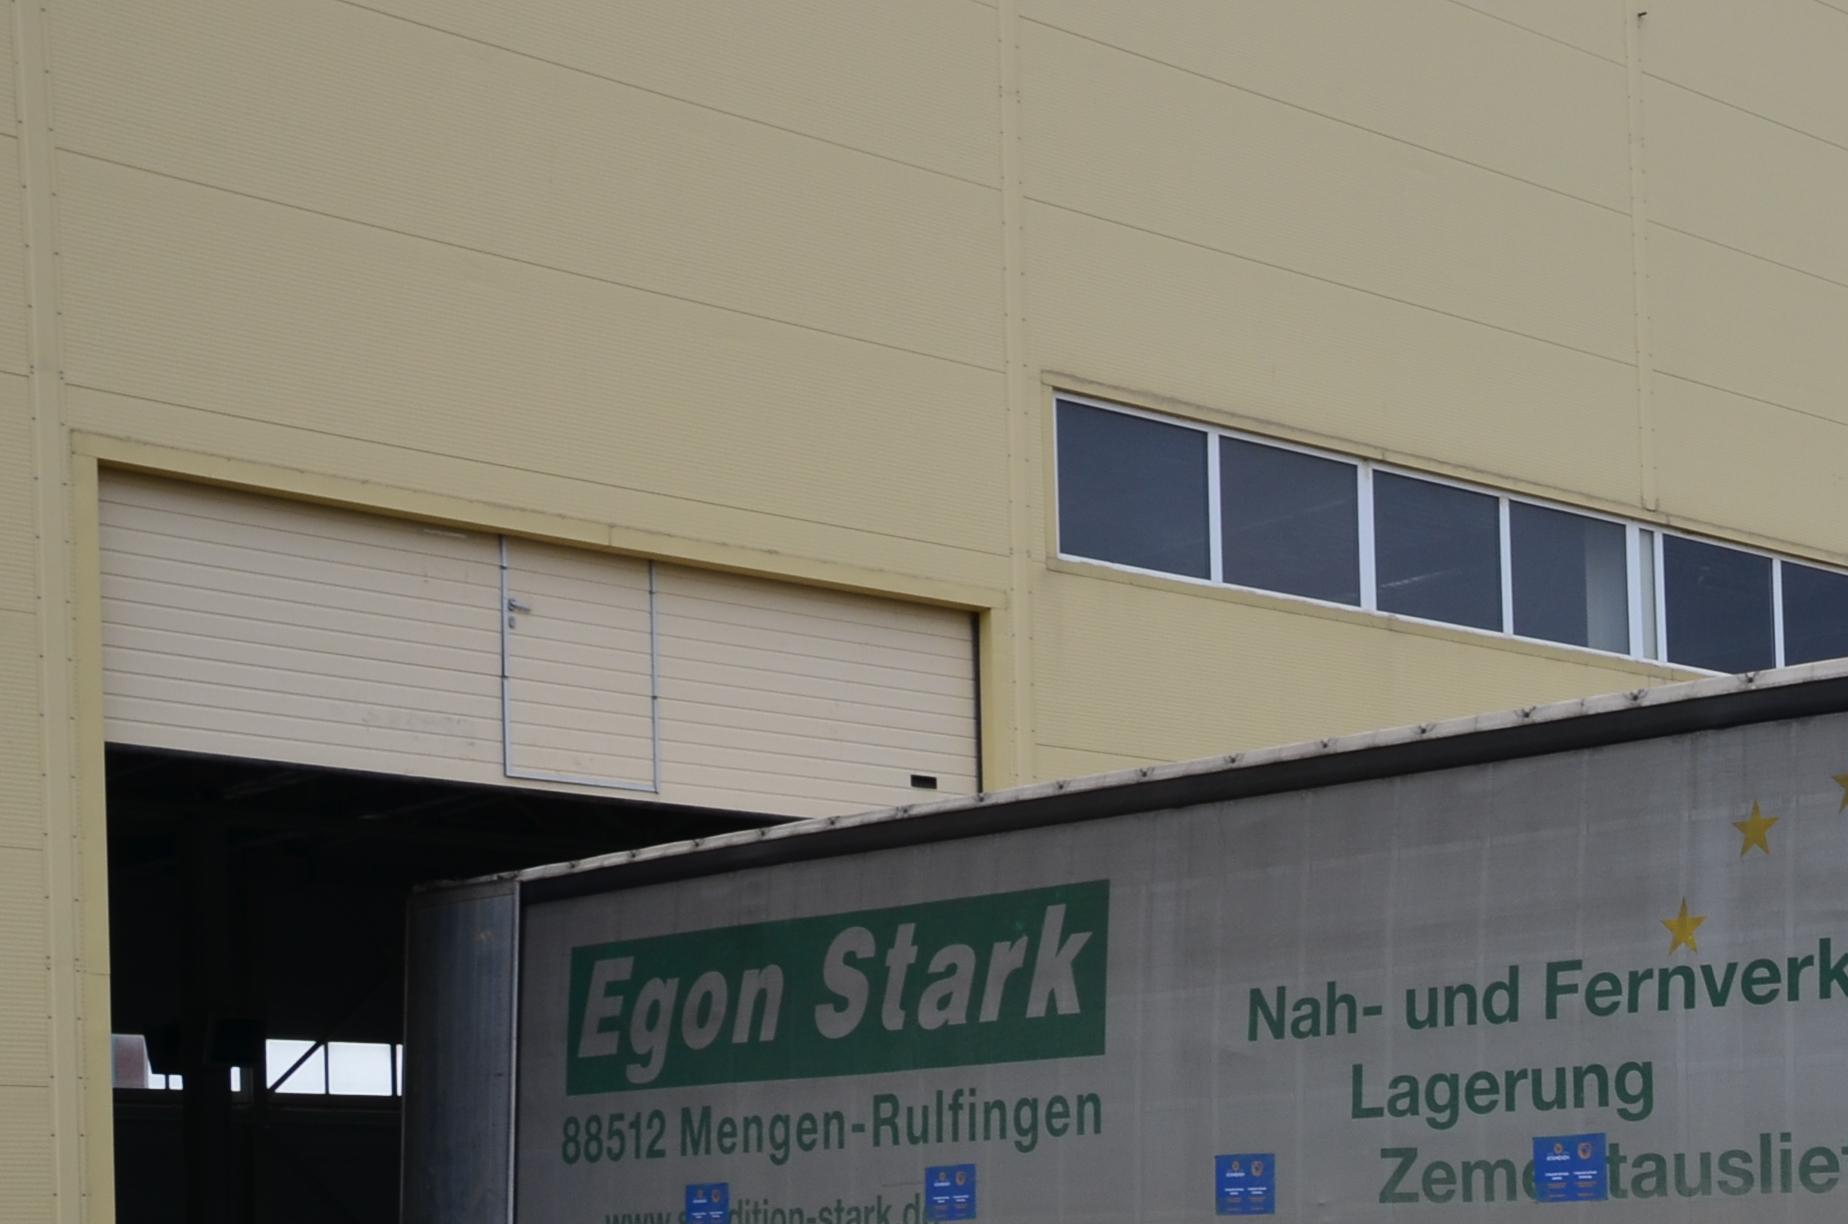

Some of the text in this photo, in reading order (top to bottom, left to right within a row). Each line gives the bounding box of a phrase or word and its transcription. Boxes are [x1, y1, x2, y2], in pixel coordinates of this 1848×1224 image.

[577, 902, 1094, 1085] Egon Stark
[1247, 980, 1385, 1043] Nah-
[1405, 965, 1521, 1032] und
[561, 1087, 1103, 1167] 88512 Mengen-Rulfingen
[1351, 1060, 1655, 1132] Lagerung
